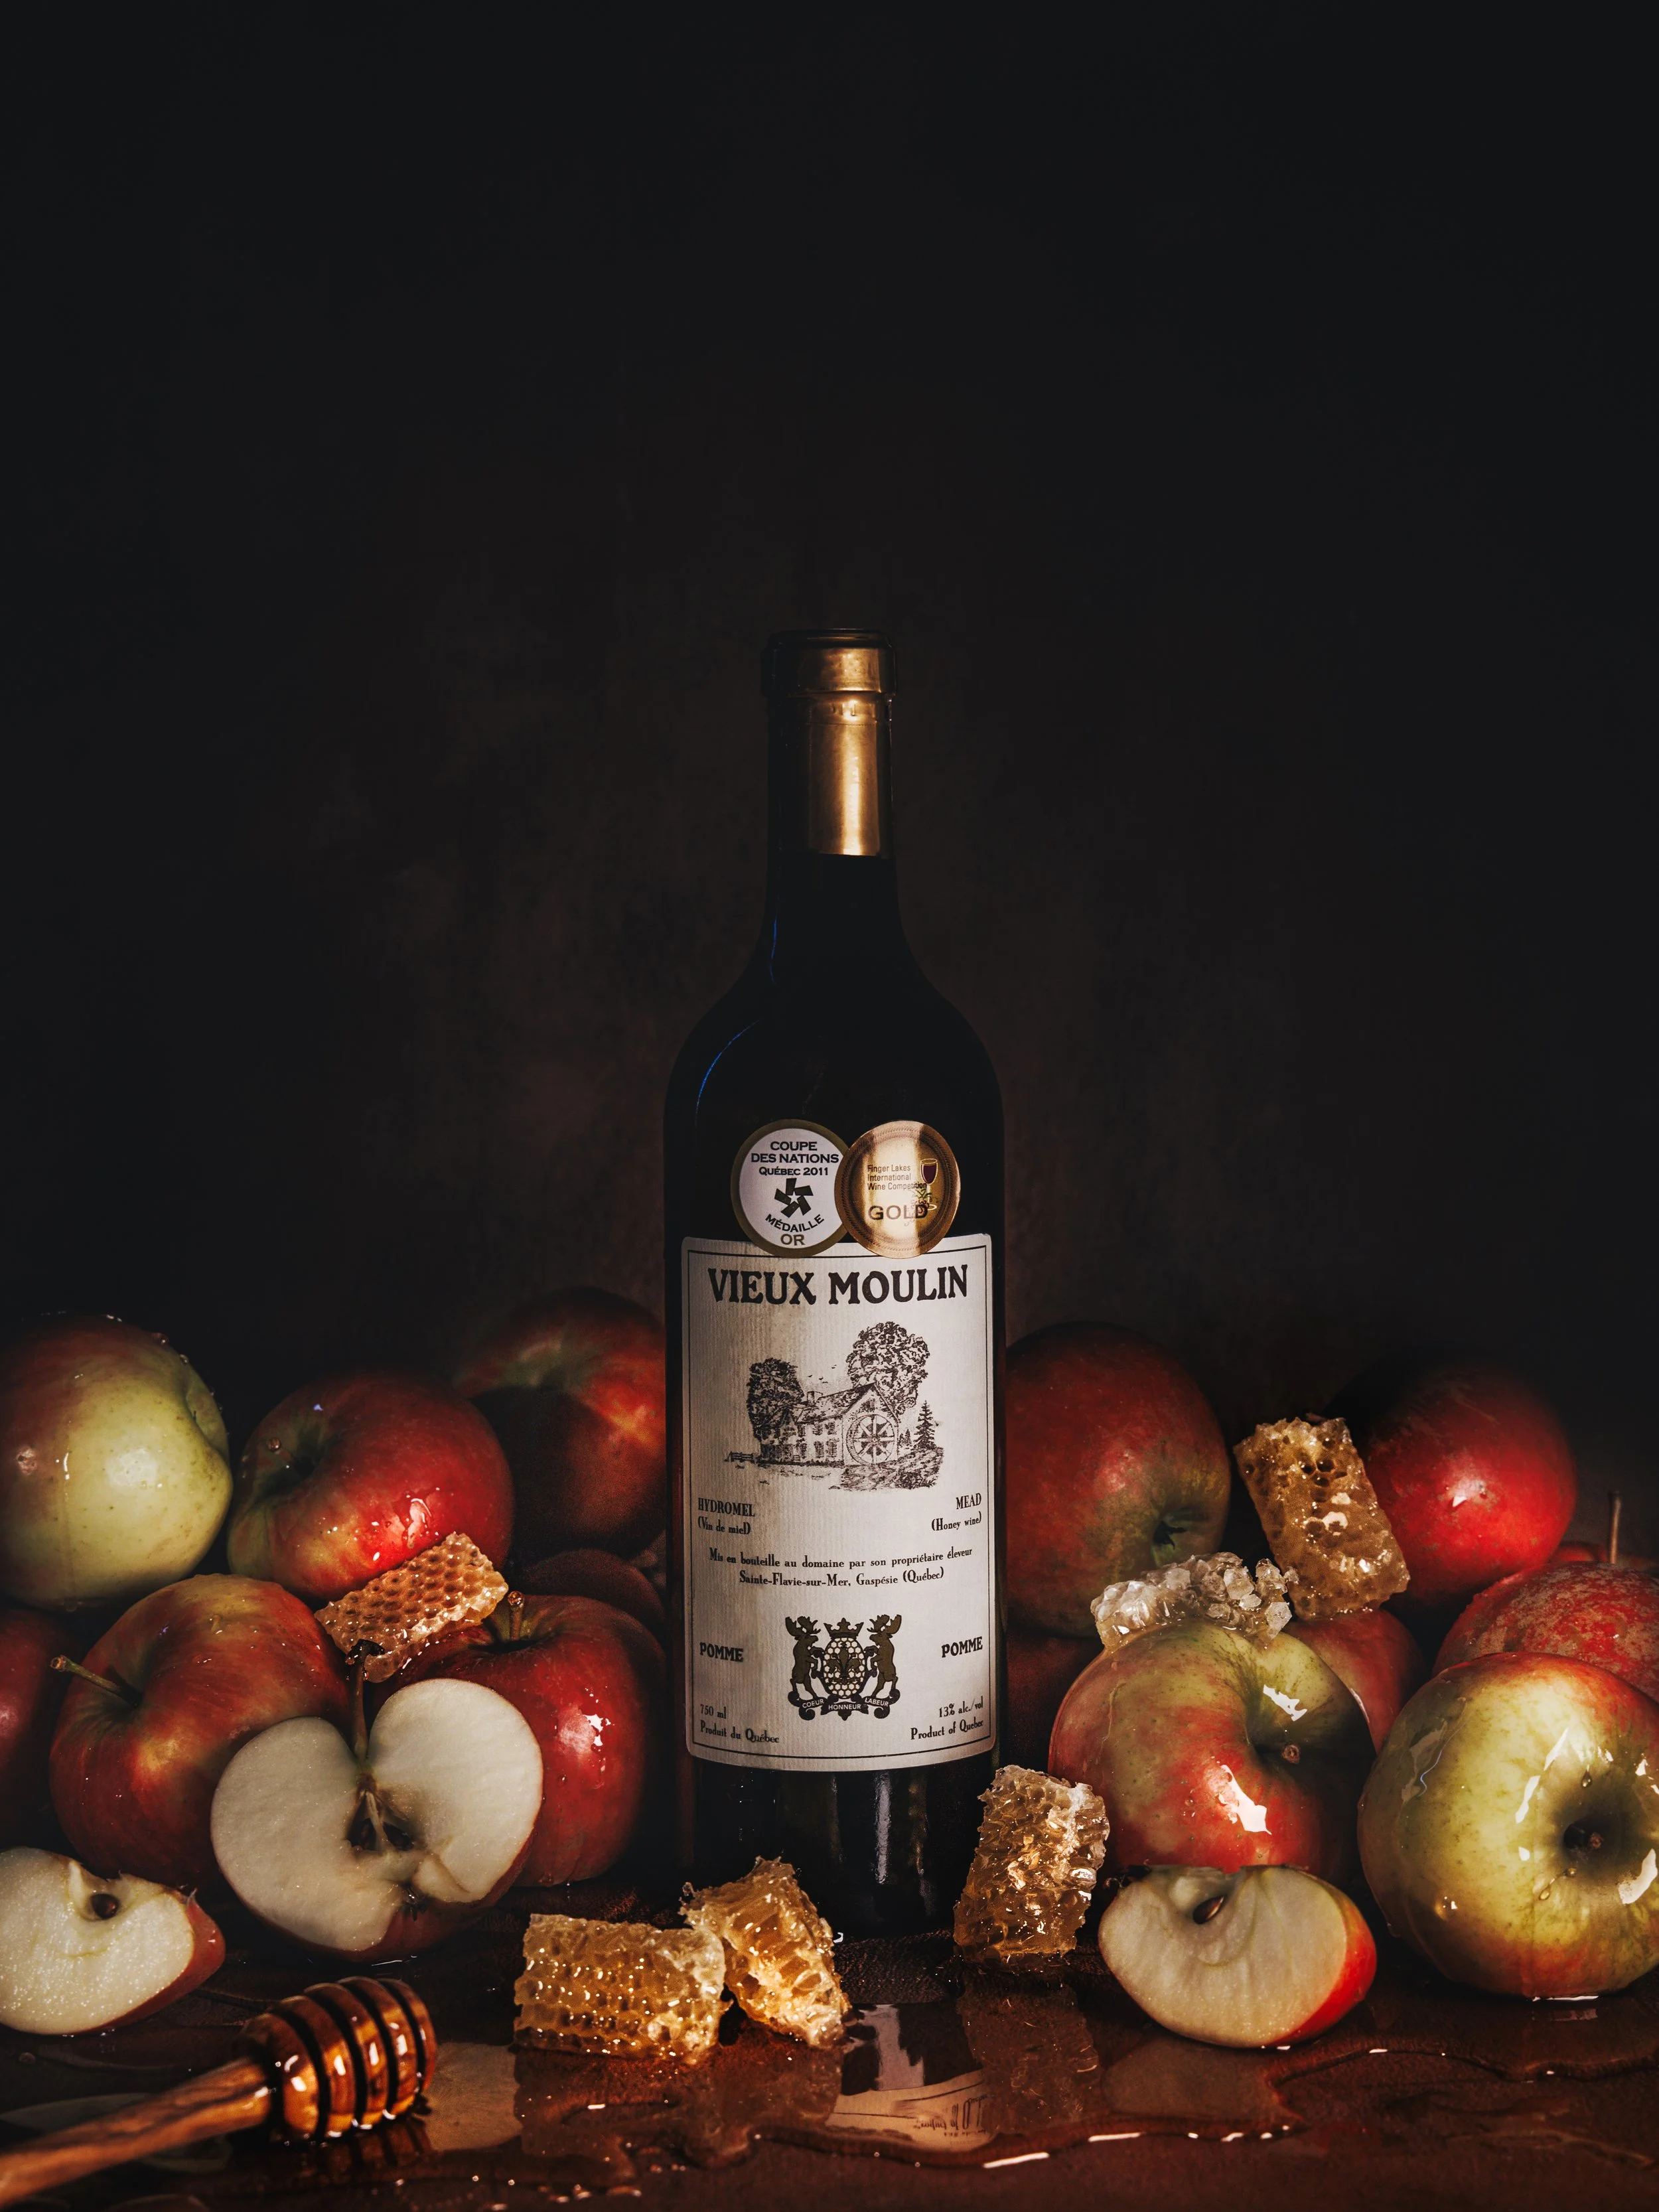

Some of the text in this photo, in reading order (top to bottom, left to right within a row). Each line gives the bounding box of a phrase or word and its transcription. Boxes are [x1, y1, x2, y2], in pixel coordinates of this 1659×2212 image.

[770, 1141, 818, 1151] COUPE
[751, 1153, 839, 1163] DES NATIONS
[803, 1167, 828, 1176] 2011
[867, 1165, 889, 1173] Finger
[888, 1182, 927, 1191] Competition
[868, 1205, 928, 1220] GOLD
[765, 1214, 824, 1232] MÉDAILLE
[780, 1234, 805, 1246] OR
[707, 1264, 968, 1305] VIEUX MOULIN
[698, 1497, 755, 1517] HYDROMEL
[956, 1493, 981, 1510] MEAD
[716, 1519, 725, 1532] de
[931, 1511, 982, 1531] (Honey wine)
[709, 1547, 723, 1562] Mis
[727, 1555, 737, 1564] en
[741, 1552, 780, 1567] bouteille
[802, 1555, 845, 1568] domaine
[849, 1560, 866, 1570] par
[891, 1553, 944, 1568] propriétaire
[947, 1546, 973, 1559] éleveur
[739, 1566, 944, 1587] Sainte-Flavie-sur-Mer, Gaspésie (Québec)
[699, 1642, 744, 1662] POMME
[941, 1636, 983, 1659] POMME
[700, 1704, 727, 1719] 750 ml
[802, 1698, 824, 1709] COEUR
[865, 1697, 889, 1707] LABEUR
[939, 1695, 983, 1718] 13% alc./vol
[700, 1720, 780, 1743] Produit du Québec
[910, 1726, 945, 1740] Product
[948, 1721, 956, 1734] of
